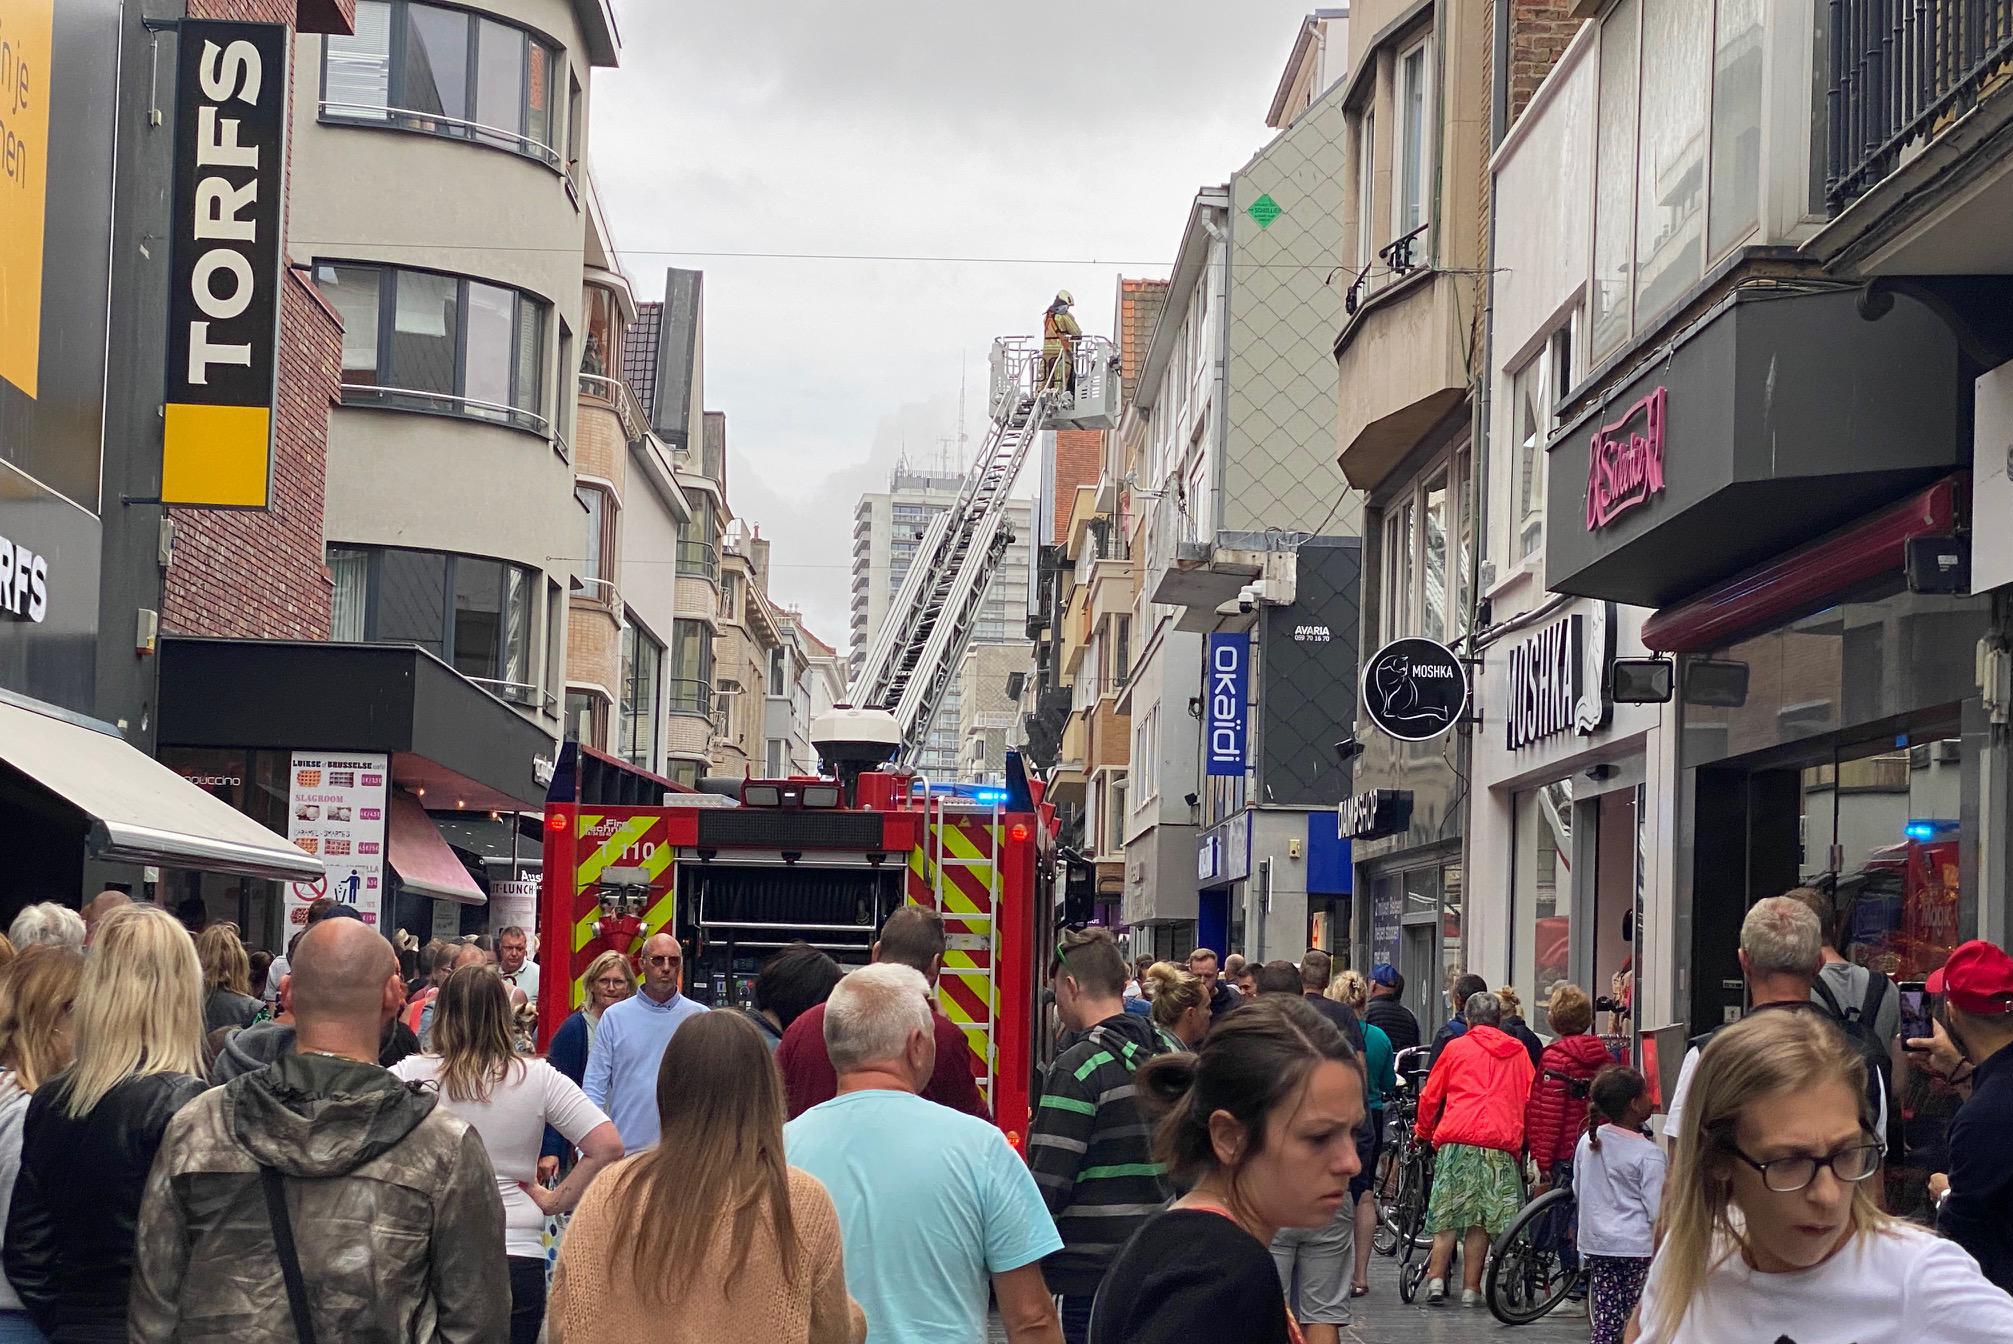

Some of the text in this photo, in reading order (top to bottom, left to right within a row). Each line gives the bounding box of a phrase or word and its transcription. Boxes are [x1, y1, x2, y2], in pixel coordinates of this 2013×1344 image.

[12, 40, 29, 115] je
[188, 39, 262, 384] TORFS
[1294, 625, 1330, 636] AVARIA
[1412, 665, 1454, 679] MOSHKA
[1507, 614, 1574, 751] MOSHKA
[1212, 646, 1241, 762] okaïdi
[327, 761, 372, 770] BRUSSELSE
[295, 794, 344, 803] SLAGROOM
[1337, 788, 1378, 840] DAMPSHOP
[596, 840, 656, 861] T 110
